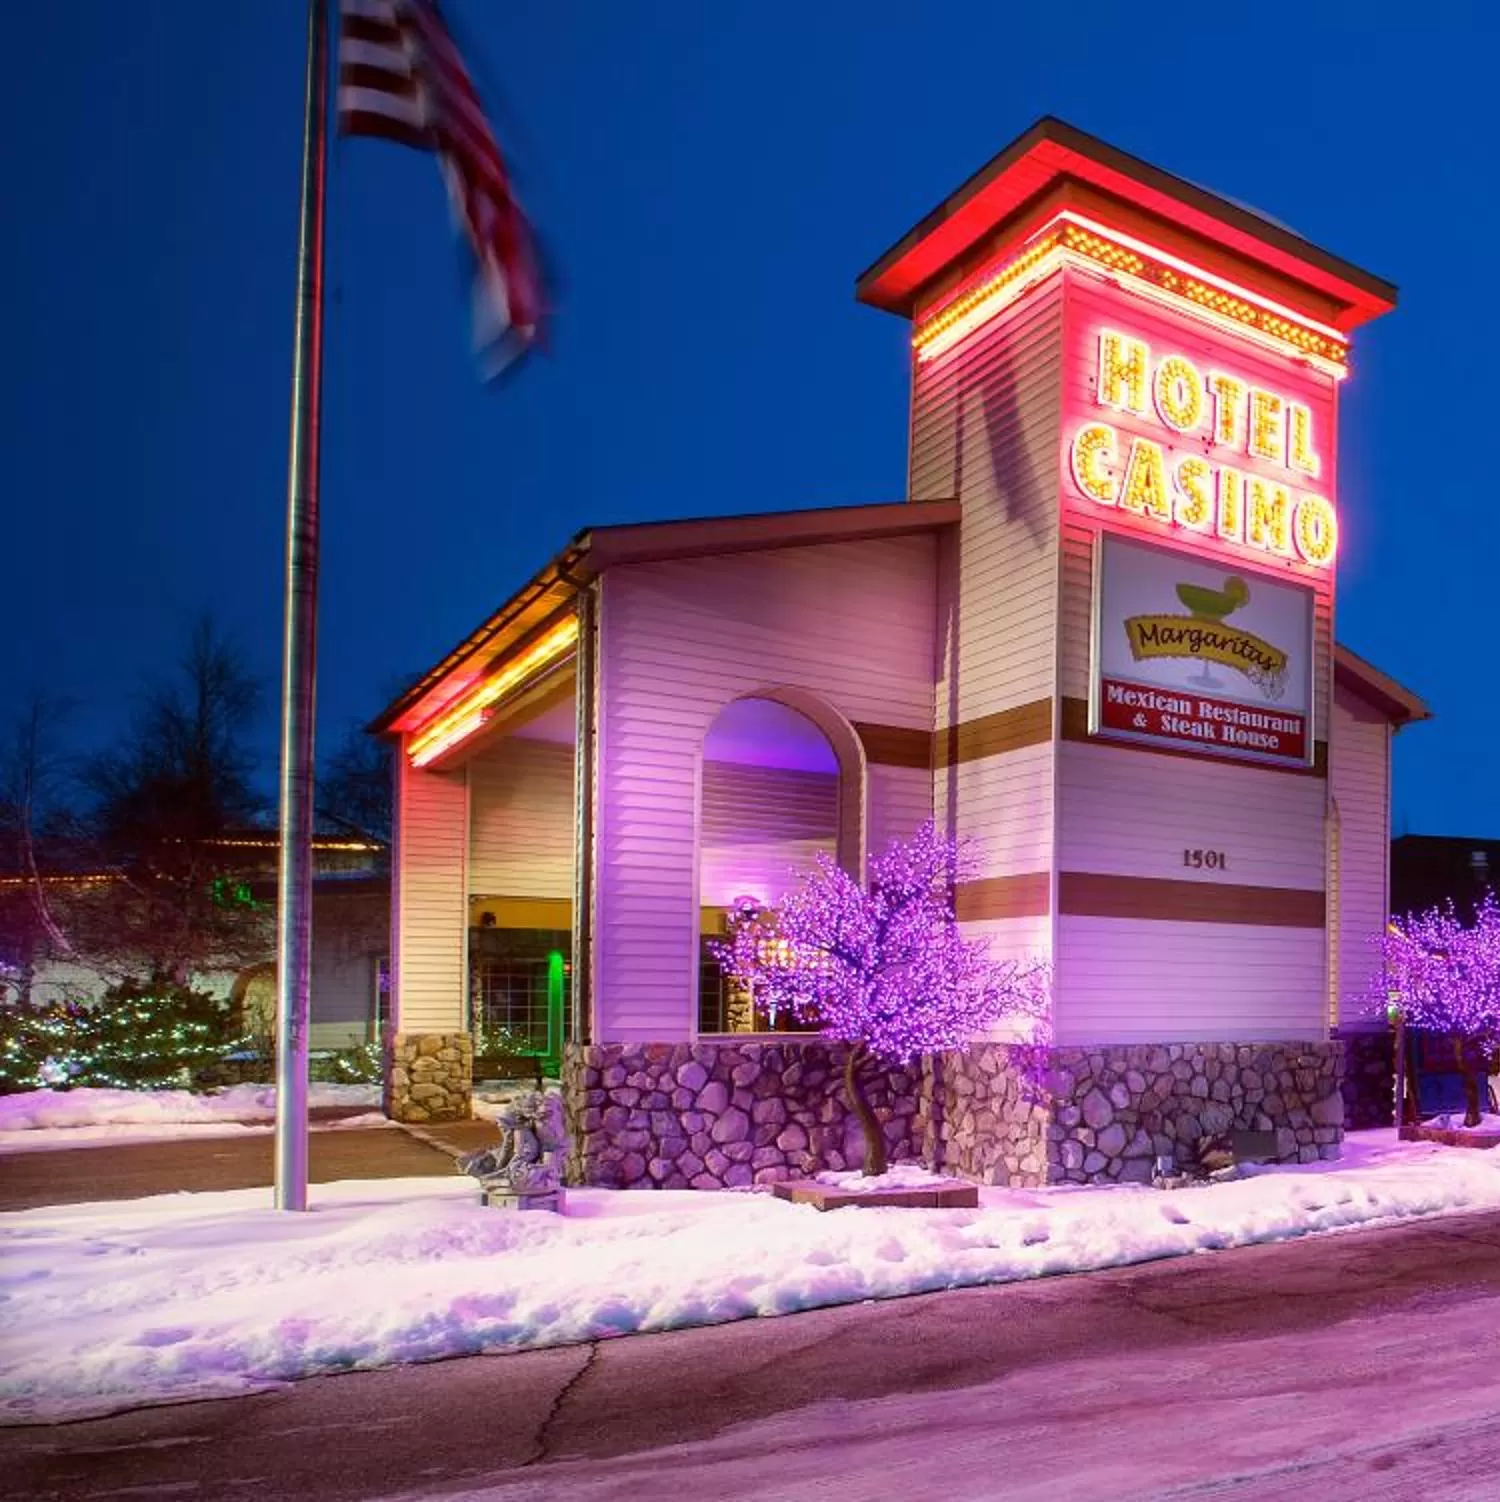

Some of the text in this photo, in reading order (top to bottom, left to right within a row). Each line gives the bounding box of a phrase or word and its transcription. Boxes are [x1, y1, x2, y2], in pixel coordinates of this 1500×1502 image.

[1097, 327, 1321, 478] HOTEL
[1070, 422, 1338, 565] CASINO
[1138, 624, 1277, 671] Margaritas
[1107, 685, 1300, 734] Mexican Restaurant
[1132, 713, 1279, 749] & Steak House
[1183, 849, 1225, 871] 1501
